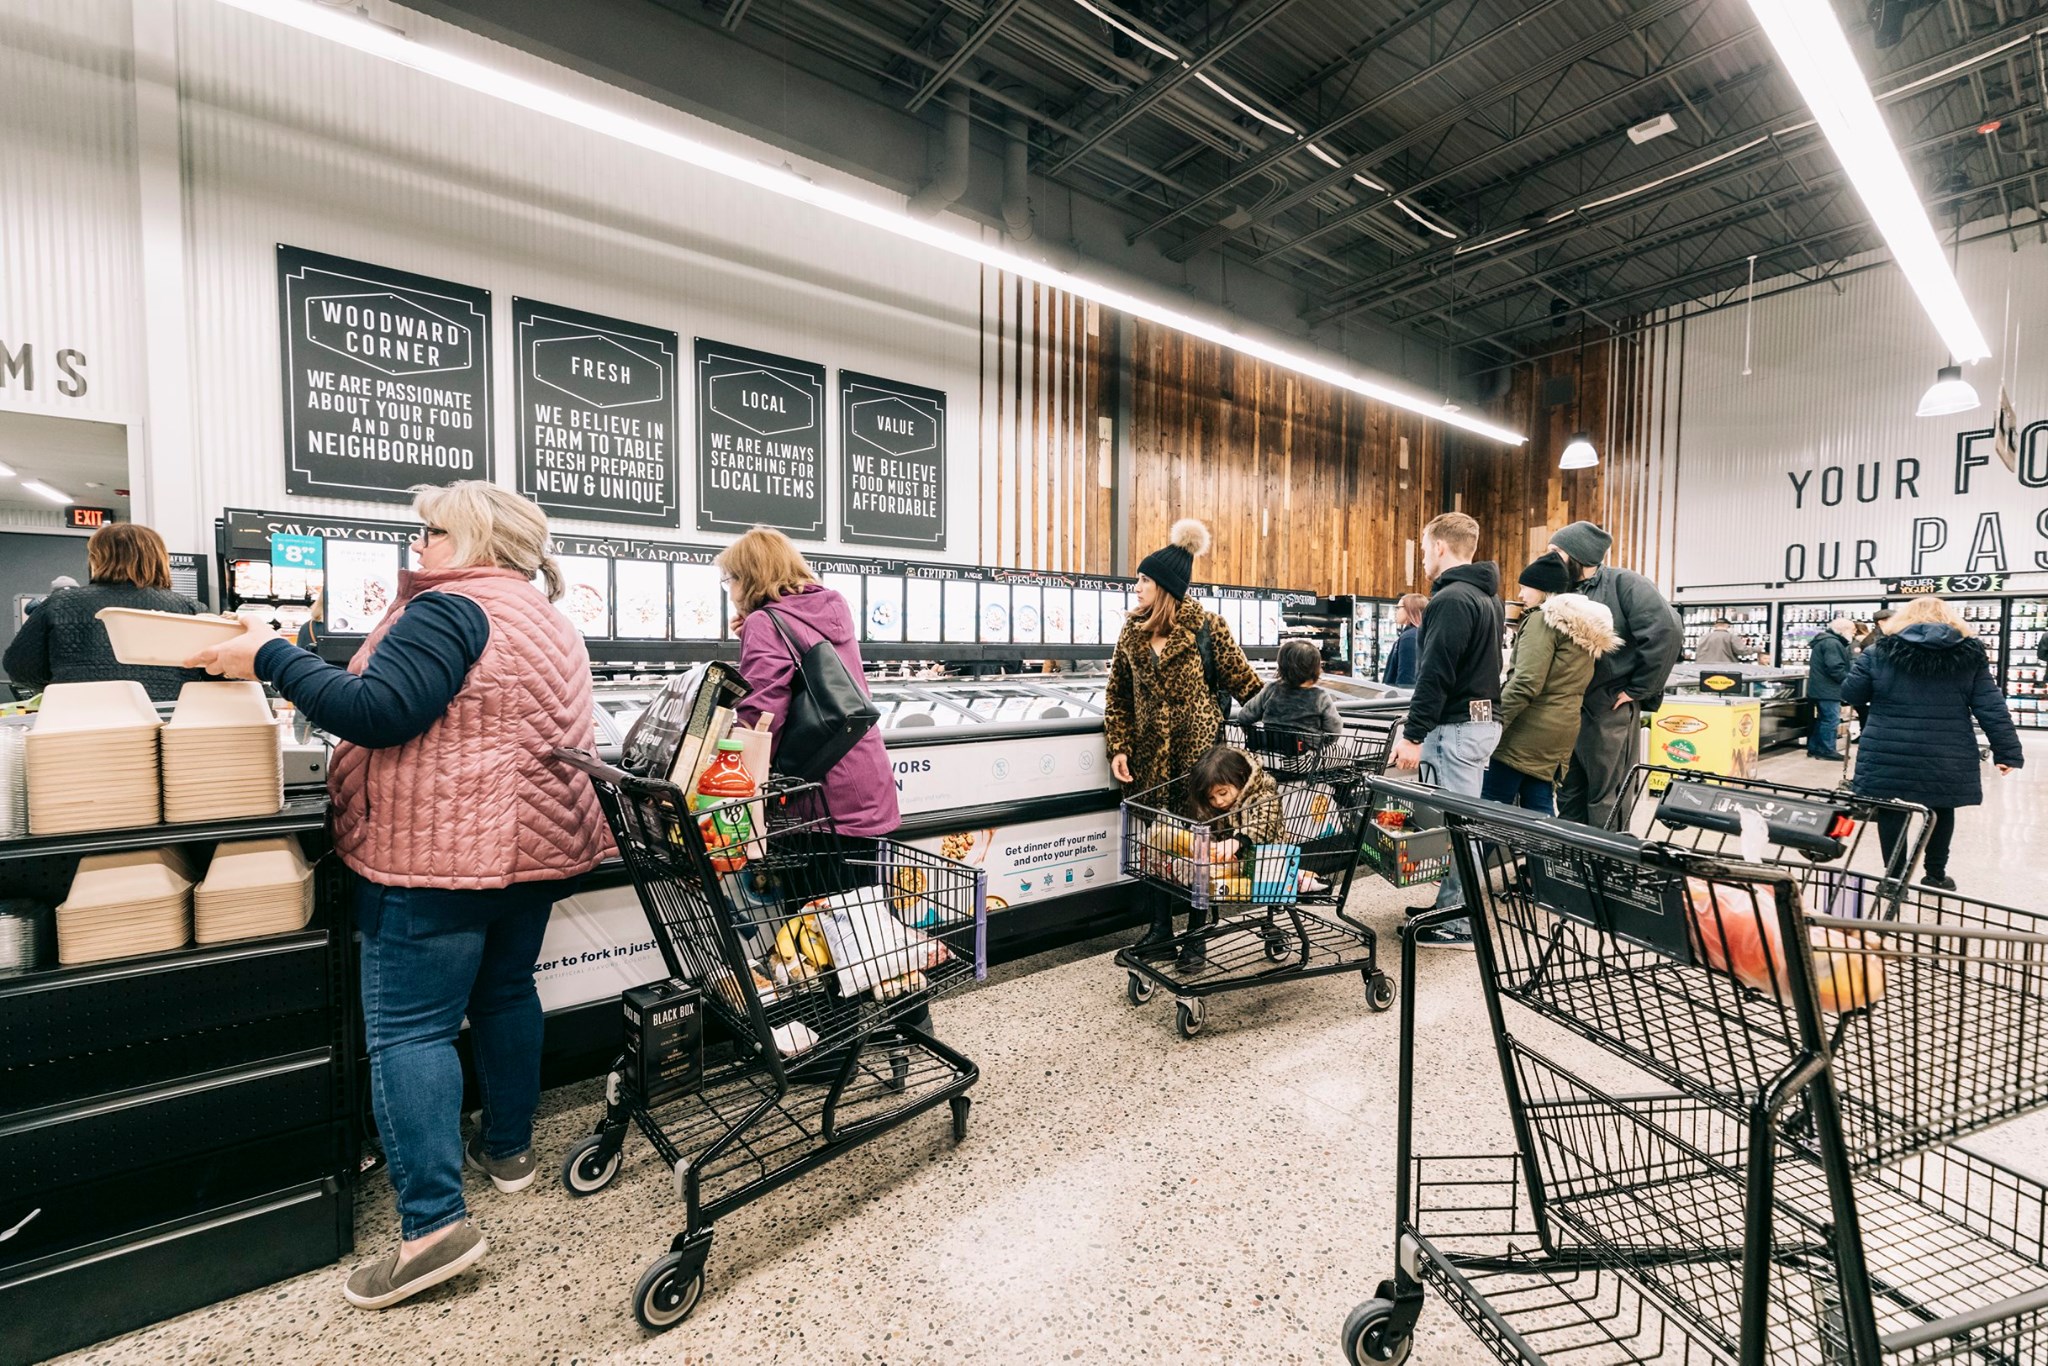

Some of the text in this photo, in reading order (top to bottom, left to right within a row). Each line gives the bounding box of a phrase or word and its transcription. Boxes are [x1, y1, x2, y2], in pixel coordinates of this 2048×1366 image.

[321, 300, 459, 346] WOODWARD
[346, 331, 440, 367] CORNER
[571, 356, 631, 385] FRESH
[306, 369, 472, 411] WE ARE PASSIONATE
[742, 390, 786, 414] LOCAL
[308, 391, 473, 430] ABOUT YOUR FOOD
[535, 403, 664, 441] WE BELIEVE IN
[352, 417, 435, 443] AND OUR
[876, 415, 915, 436] VALUE
[308, 430, 474, 471] NEIGHBORHOOD
[535, 424, 664, 462] FARM TO TABLE
[711, 432, 814, 462] WE ARE ALWAYS
[536, 448, 664, 481] FRESH PREPARED
[711, 450, 814, 479] SEARCHING FOR
[852, 454, 937, 484] WE BELIEVE
[536, 469, 664, 504] NEW & UNIQUE
[711, 467, 814, 499] LOCAL ITEMS
[852, 473, 937, 499] FOOD MUST BE
[1787, 458, 1920, 509] YOUR
[74, 509, 104, 526] EXIT
[852, 491, 937, 518] AFFORDABLE
[918, 567, 983, 580] CERTIFIED ANGUS
[1784, 539, 1878, 582] OUR
[1079, 579, 1103, 590] FRESH
[1900, 585, 1936, 594] YOGURT
[1005, 830, 1107, 857] Get dinner off your mind
[1013, 844, 1098, 867] and onto your plate.
[561, 956, 578, 967] to
[580, 949, 611, 963] fork
[614, 946, 627, 956] in
[629, 939, 658, 956] just
[653, 1007, 678, 1027] BLACK
[680, 1002, 695, 1018] BOX
